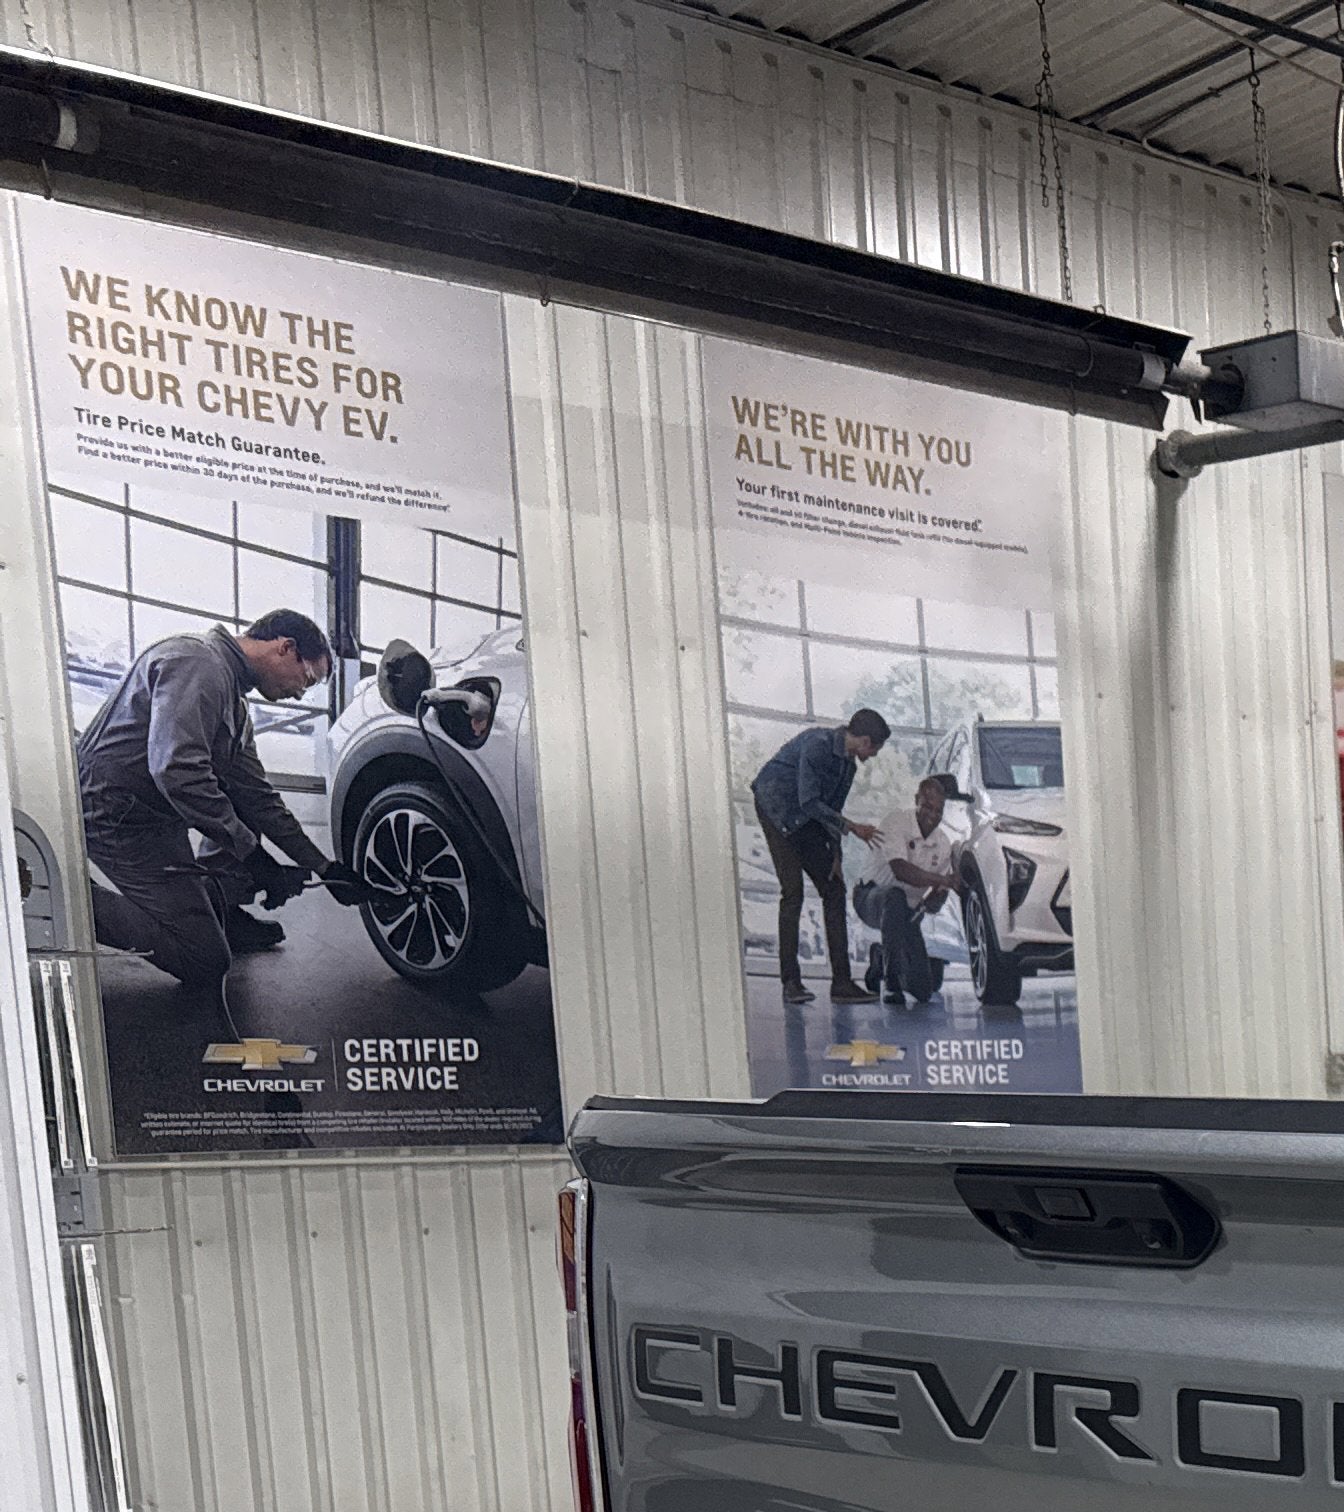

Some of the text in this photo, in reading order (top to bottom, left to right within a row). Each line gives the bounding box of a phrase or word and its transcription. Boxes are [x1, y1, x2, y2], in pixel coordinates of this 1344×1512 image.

[59, 265, 355, 355] WE KNOW THE
[66, 310, 404, 404] RIGHT TIRES FOR
[67, 353, 398, 444] YOUR CHEVY EV.
[73, 406, 325, 465] Tire Price Match Guarantee.
[731, 395, 971, 467] WE'RE WITH YOU
[734, 433, 931, 496] ALL THE WAY.
[735, 476, 767, 495] Your
[769, 484, 800, 502] first
[803, 493, 885, 517] maintenance
[888, 507, 914, 522] visit
[917, 511, 928, 524] is
[344, 1038, 478, 1062] CERTIFIED
[924, 1039, 1023, 1060] CERTIFIED
[203, 1078, 325, 1092] CHEVROLET
[346, 1066, 458, 1091] SERVICE
[822, 1073, 911, 1085] CHEVROLET
[926, 1063, 1009, 1085] SERVICE
